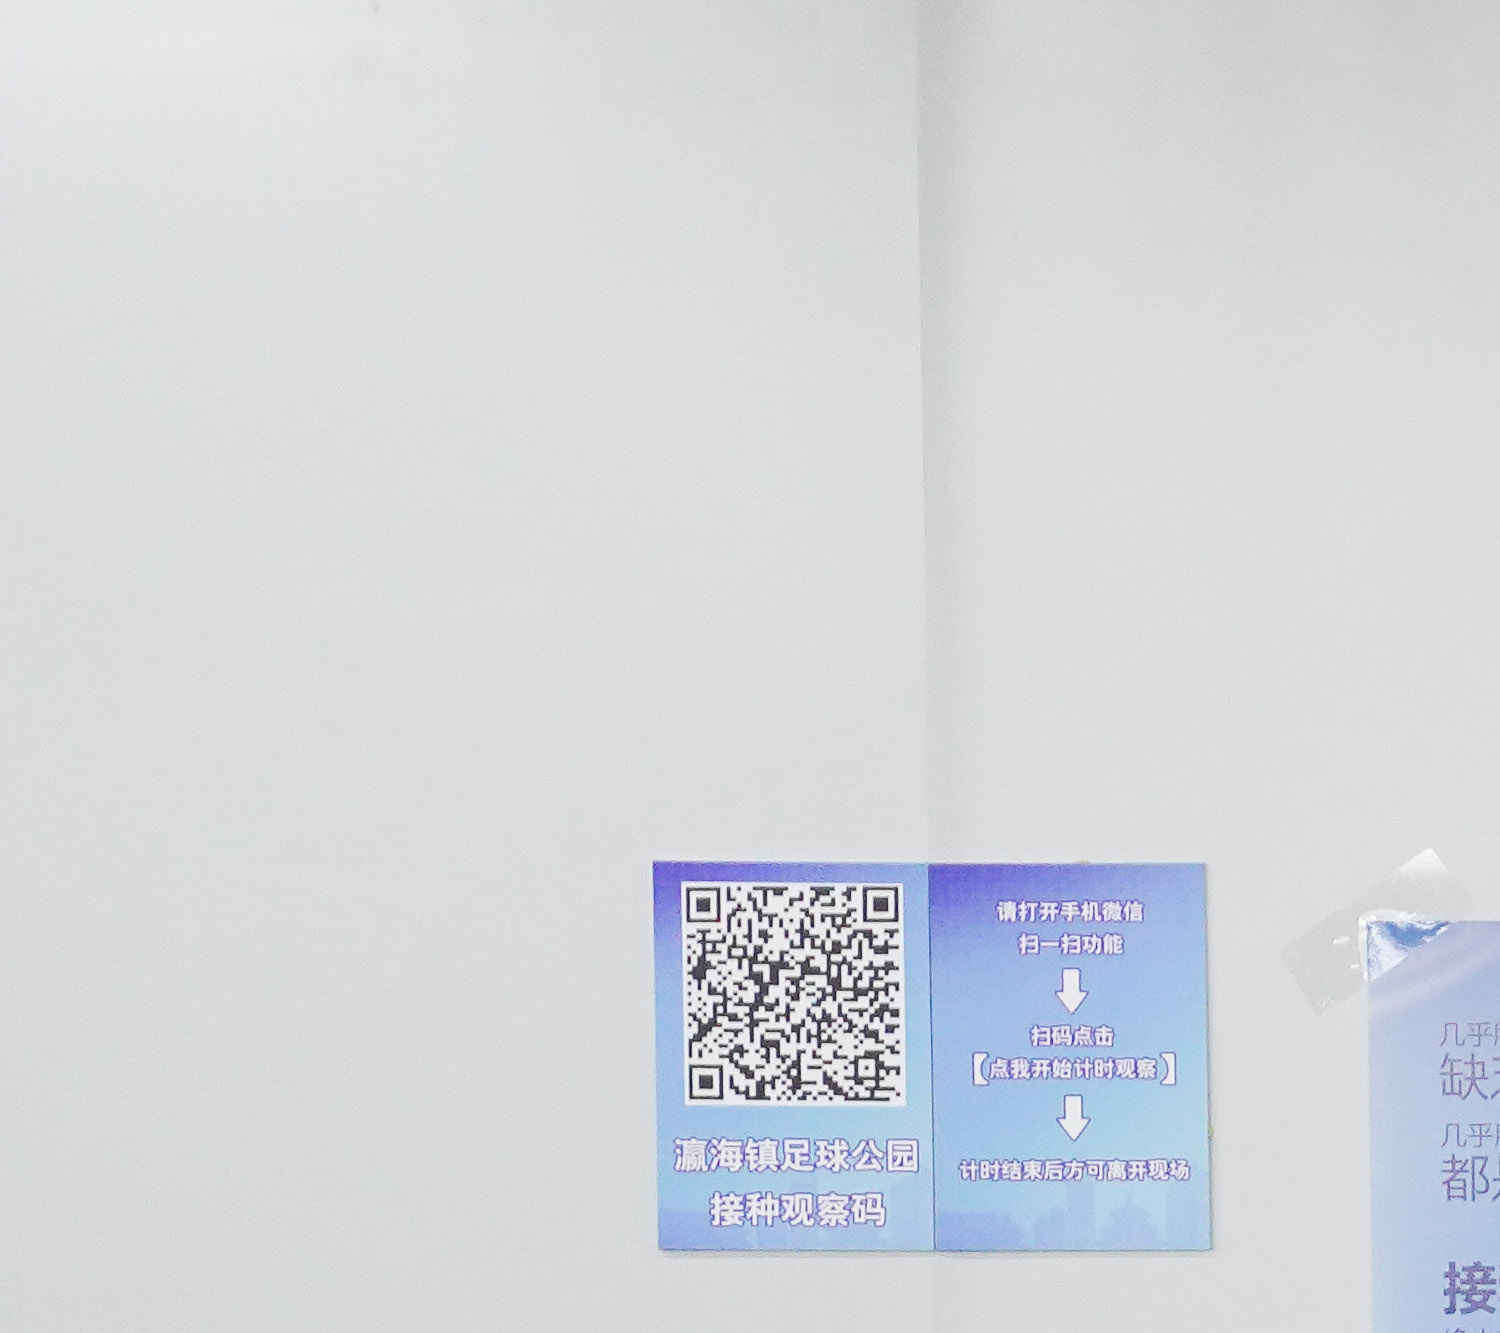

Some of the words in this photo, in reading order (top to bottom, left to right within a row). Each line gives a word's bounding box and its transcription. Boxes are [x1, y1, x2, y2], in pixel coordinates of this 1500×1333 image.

[997, 901, 1144, 922] 请打开手机微信
[1018, 934, 1124, 955] 扫一扫功能
[1030, 1026, 1115, 1047] 扫码点击
[673, 1137, 919, 1174] 瀛海镇足球公园
[959, 1159, 1190, 1182] 计时结束后方可离开现场
[710, 1191, 886, 1228] 接种观察码
